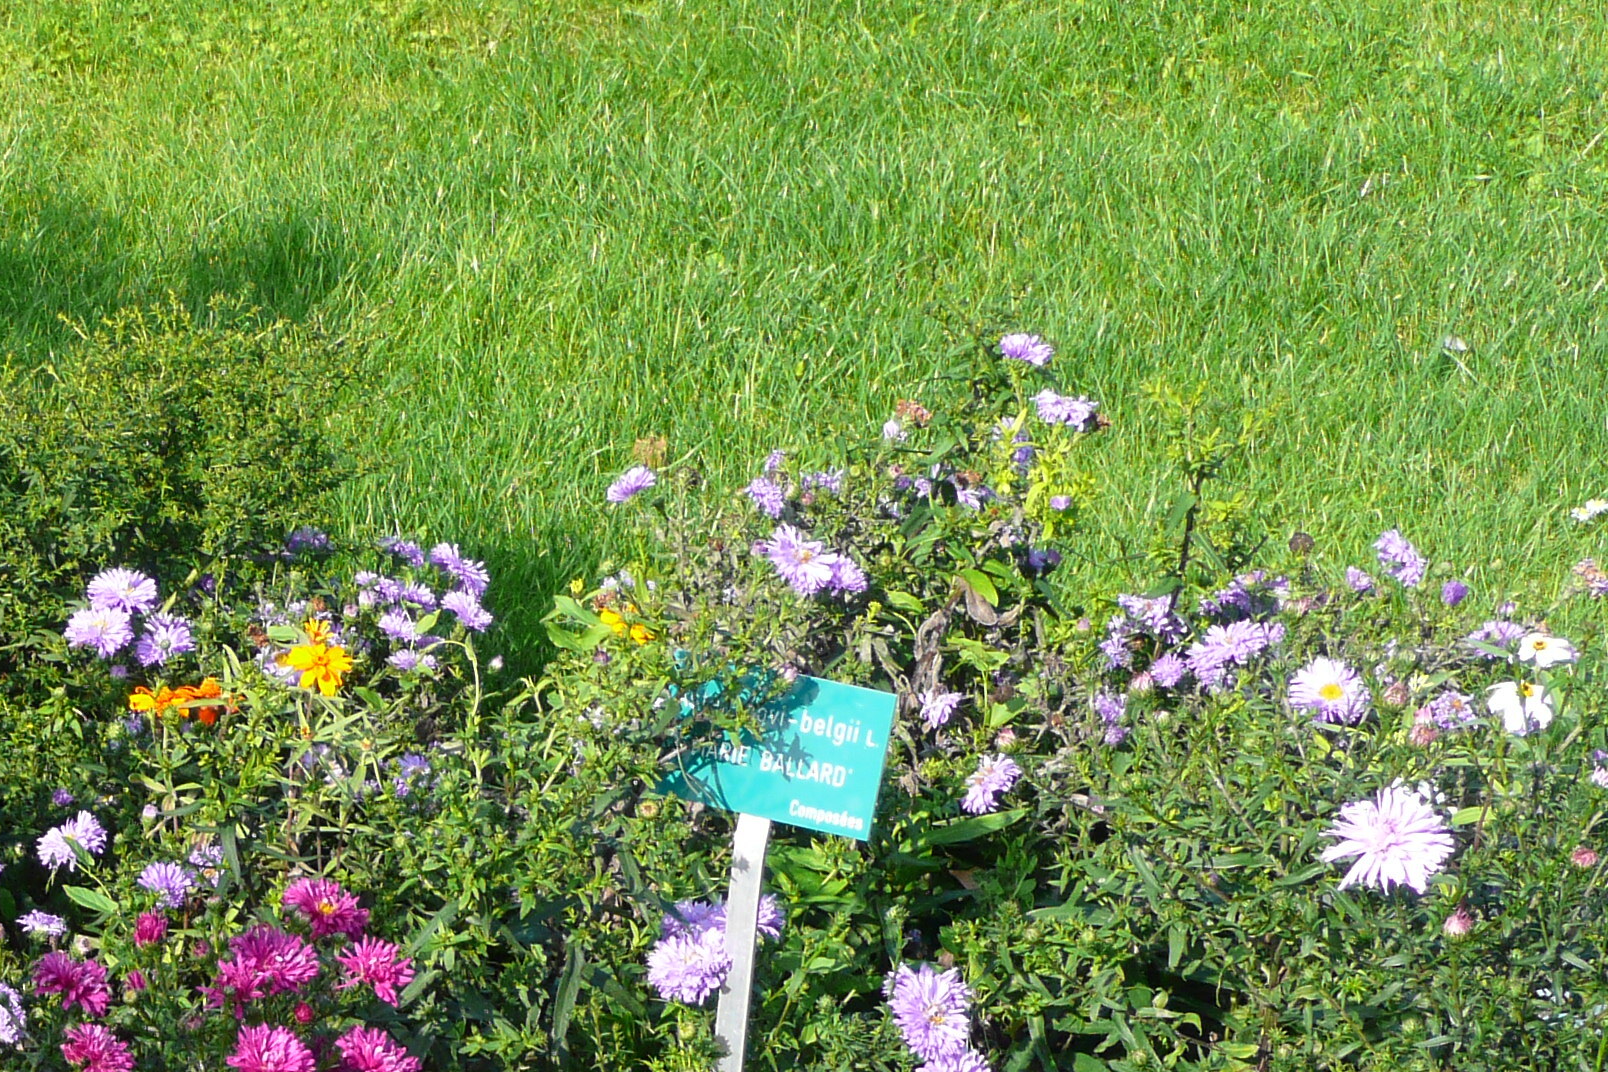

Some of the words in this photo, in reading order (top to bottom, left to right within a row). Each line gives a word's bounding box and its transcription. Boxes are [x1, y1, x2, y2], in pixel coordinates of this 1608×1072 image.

[755, 706, 859, 746] ovi-belgii
[701, 740, 751, 767] ARIE
[789, 799, 863, 830] Composées
